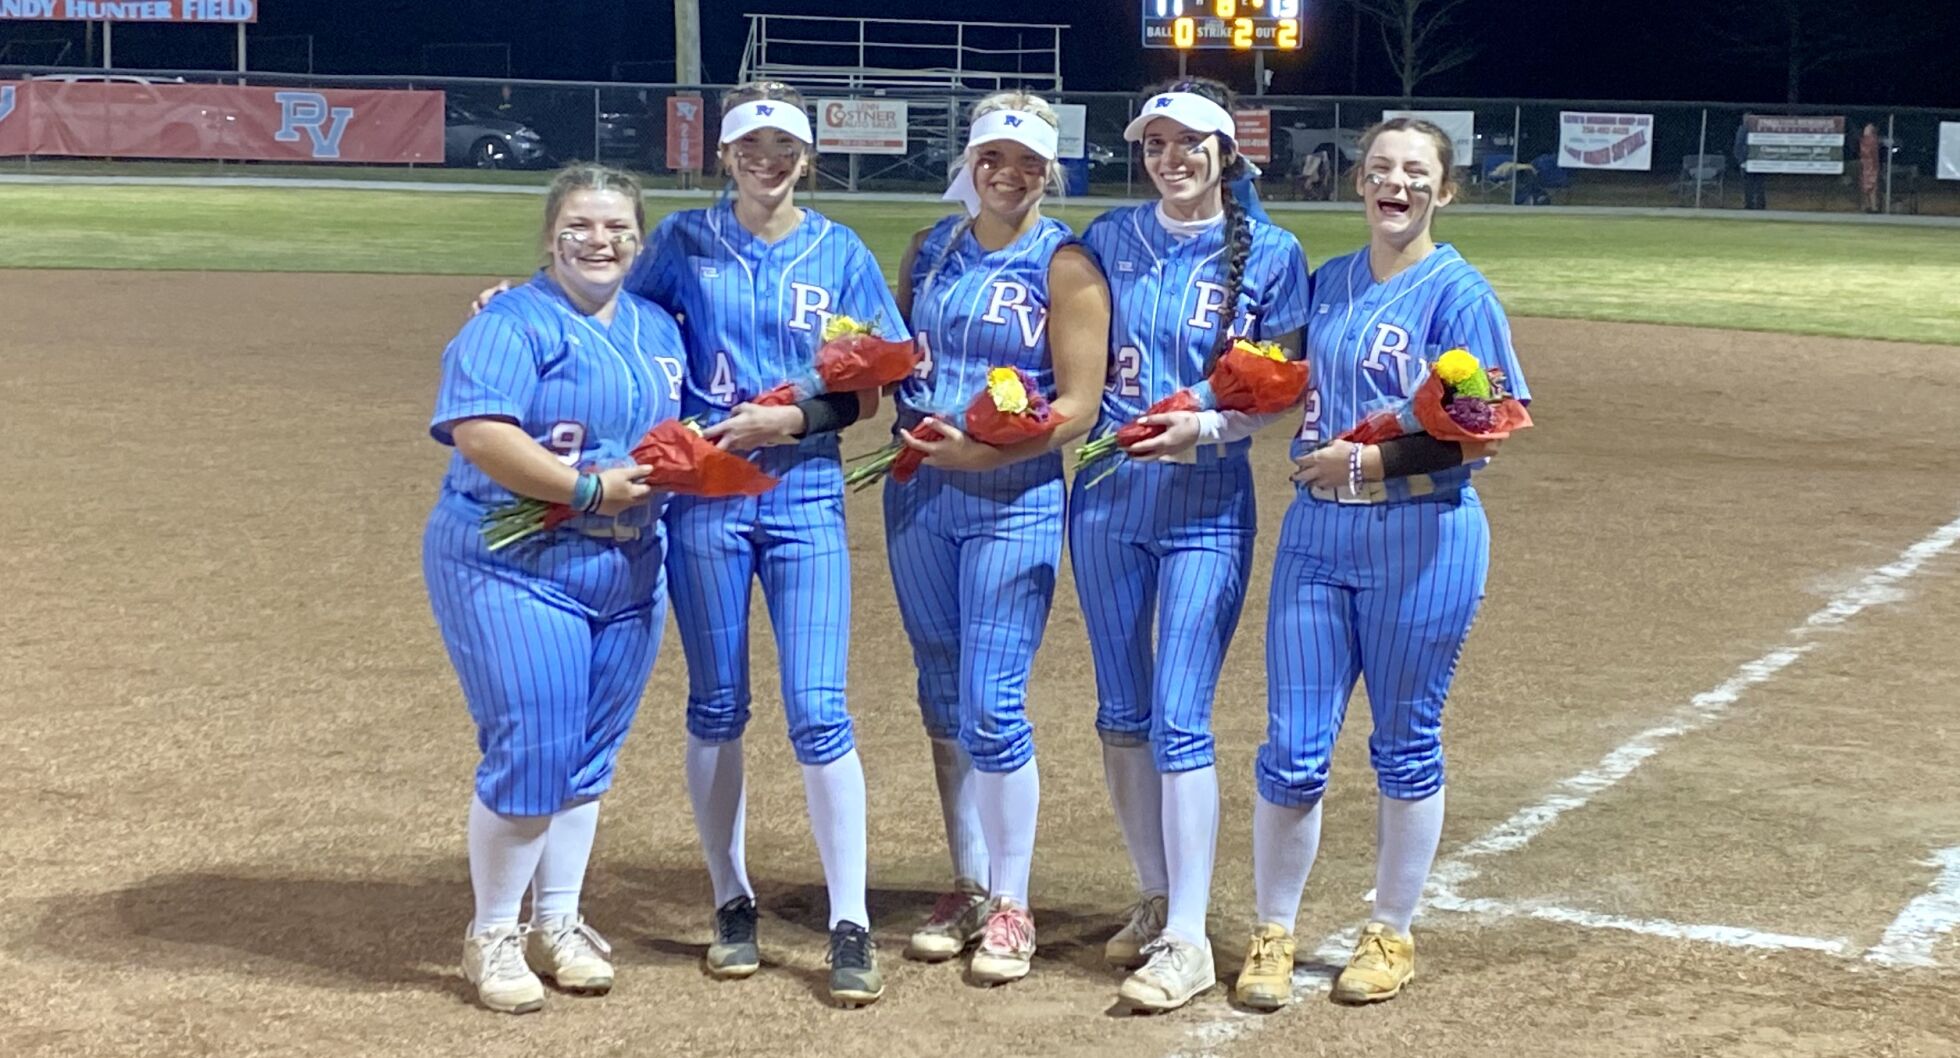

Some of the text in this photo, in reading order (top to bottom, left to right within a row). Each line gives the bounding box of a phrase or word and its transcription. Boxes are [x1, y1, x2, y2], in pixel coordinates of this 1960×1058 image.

[0, 0, 253, 20] NDY HUNTER FIELD
[1147, 17, 1297, 48] BALL 0 STRIKE 2 OUT 2
[274, 91, 354, 158] PV
[756, 104, 775, 117] PV
[826, 102, 897, 128] COSTNER
[1004, 115, 1023, 128] PV
[1155, 97, 1174, 108] PV
[982, 280, 1047, 348] PV
[654, 355, 683, 401] P
[710, 352, 736, 402] 4
[1106, 346, 1141, 397] 2
[1363, 322, 1431, 398] PV
[552, 421, 584, 466] 9
